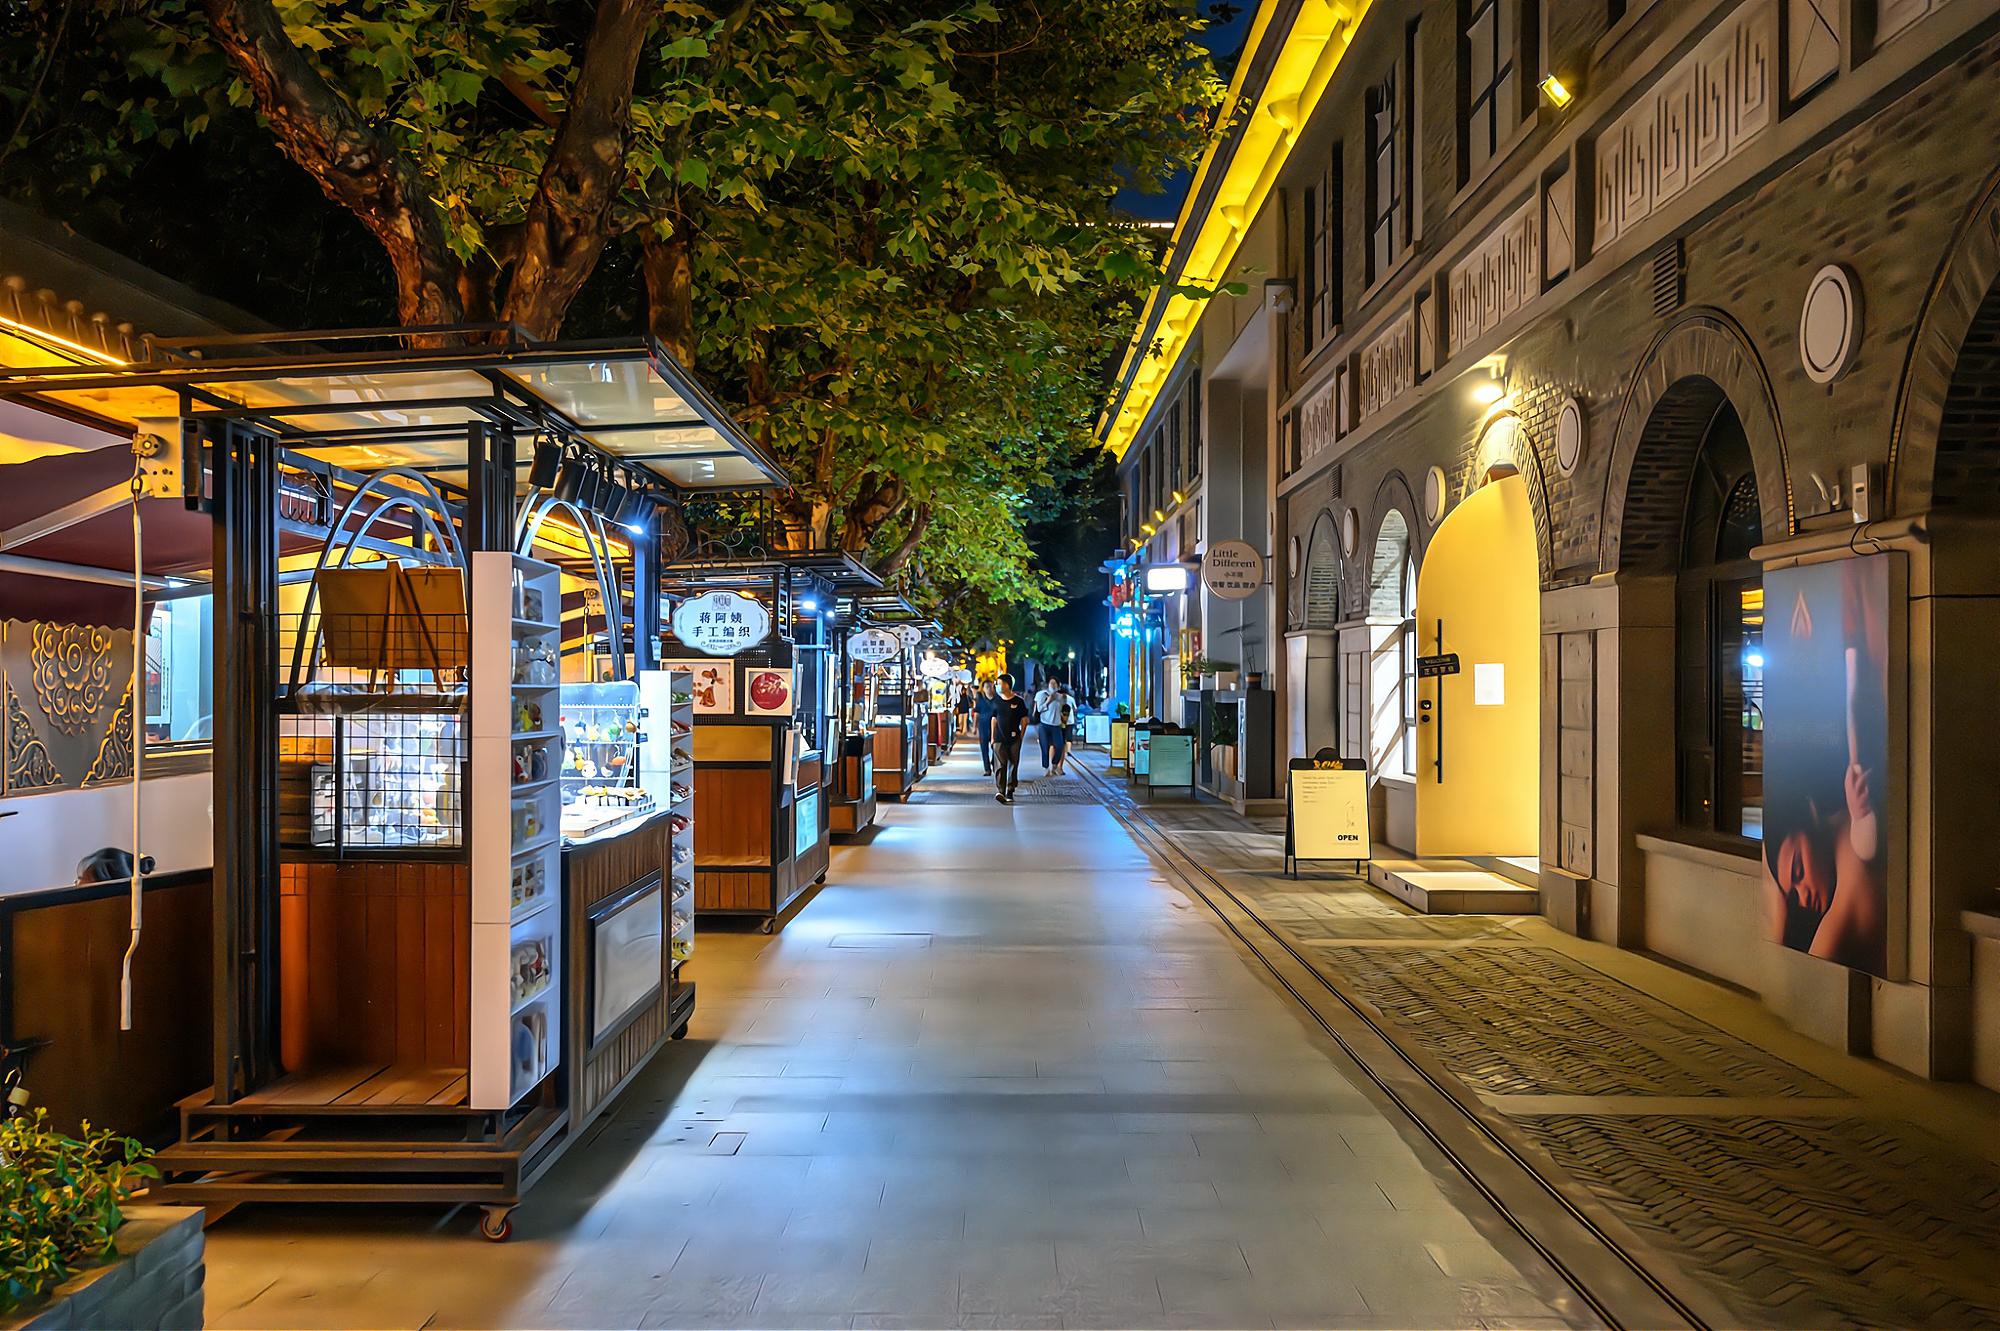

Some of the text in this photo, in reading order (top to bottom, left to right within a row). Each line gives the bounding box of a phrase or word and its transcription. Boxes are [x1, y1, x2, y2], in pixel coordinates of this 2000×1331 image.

[1213, 549, 1239, 558] Little
[1212, 559, 1256, 568] Different
[699, 612, 742, 624] 蒋阿姨
[692, 626, 750, 638] 手工编织
